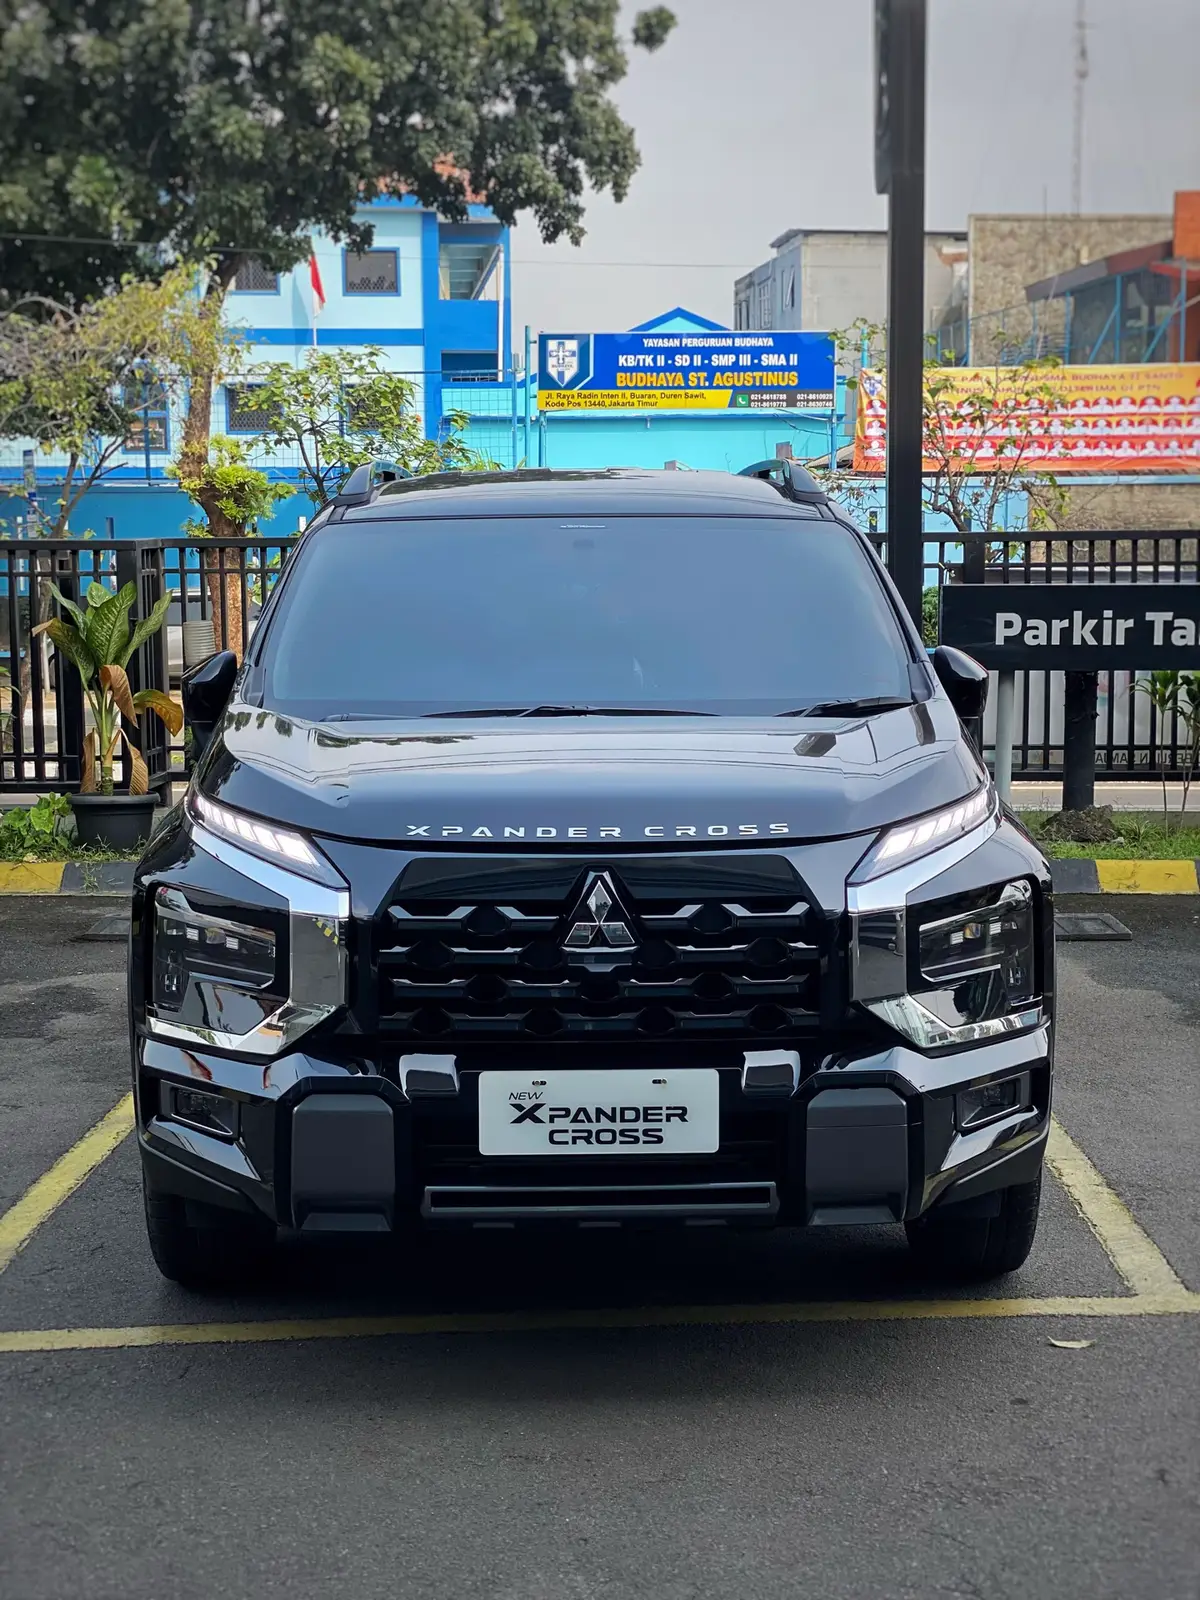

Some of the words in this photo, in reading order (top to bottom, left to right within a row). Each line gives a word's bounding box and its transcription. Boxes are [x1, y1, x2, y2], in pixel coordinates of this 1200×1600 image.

[643, 338, 680, 347] YAYASAN
[682, 338, 732, 347] PERGURUAN
[734, 337, 774, 347] BUDHAYA
[618, 355, 654, 367] KB/TK
[657, 355, 665, 366] II
[675, 354, 690, 366] SD
[693, 354, 701, 366] II
[711, 354, 736, 366] SMP
[739, 354, 751, 366] III
[761, 353, 787, 366] SMA
[789, 353, 798, 366] II
[616, 372, 684, 387] BUDHAYA
[688, 372, 709, 387] ST.
[713, 371, 799, 387] AGUSTINUS
[1071, 373, 1126, 381] BUDHAYA
[556, 393, 575, 402] Raya
[576, 392, 599, 400] Radin
[600, 392, 619, 400] Inten
[630, 392, 658, 401] Buaran,
[660, 392, 683, 400] Duren
[684, 391, 706, 400] Sawit,
[545, 401, 565, 409] Kode
[584, 400, 607, 409] 13440,
[608, 400, 635, 408] Jakarta
[637, 400, 659, 408] Timur
[995, 610, 1134, 646] Parkir
[1145, 611, 1200, 646] Ta
[406, 824, 622, 838] XPANDER
[644, 822, 791, 838] CROSS
[508, 1092, 544, 1101] NEW
[509, 1103, 689, 1125] XPANDER
[548, 1128, 664, 1145] CROSS
